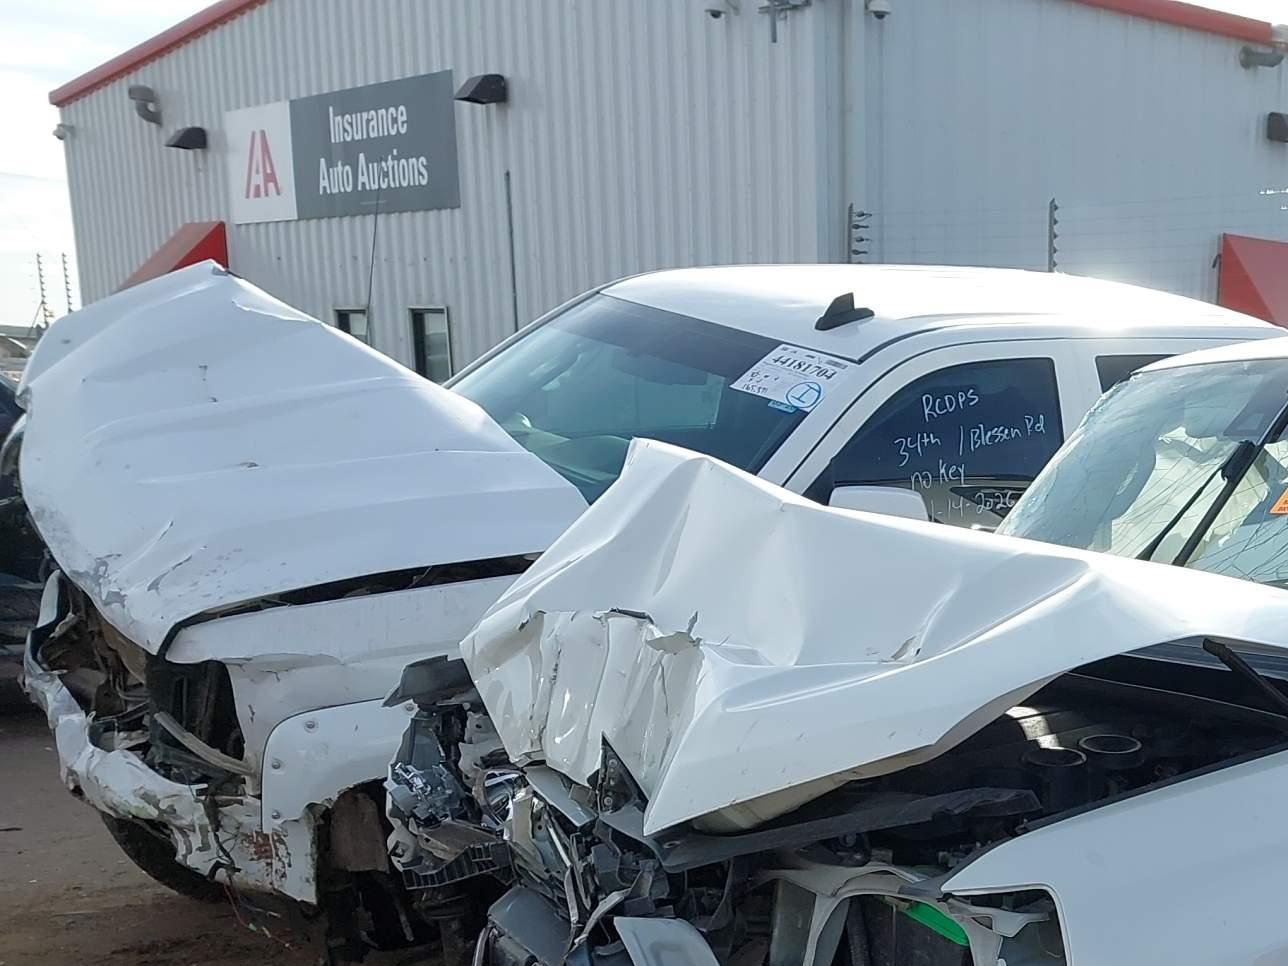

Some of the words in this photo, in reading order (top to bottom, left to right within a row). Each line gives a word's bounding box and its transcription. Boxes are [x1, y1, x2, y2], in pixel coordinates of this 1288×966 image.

[329, 105, 407, 143] Insurance
[319, 157, 353, 195] Auto
[357, 148, 429, 191] Auctions
[772, 355, 838, 380] 44181704
[921, 388, 979, 422] RCDPS
[894, 432, 942, 467] 34th
[910, 470, 932, 491] no
